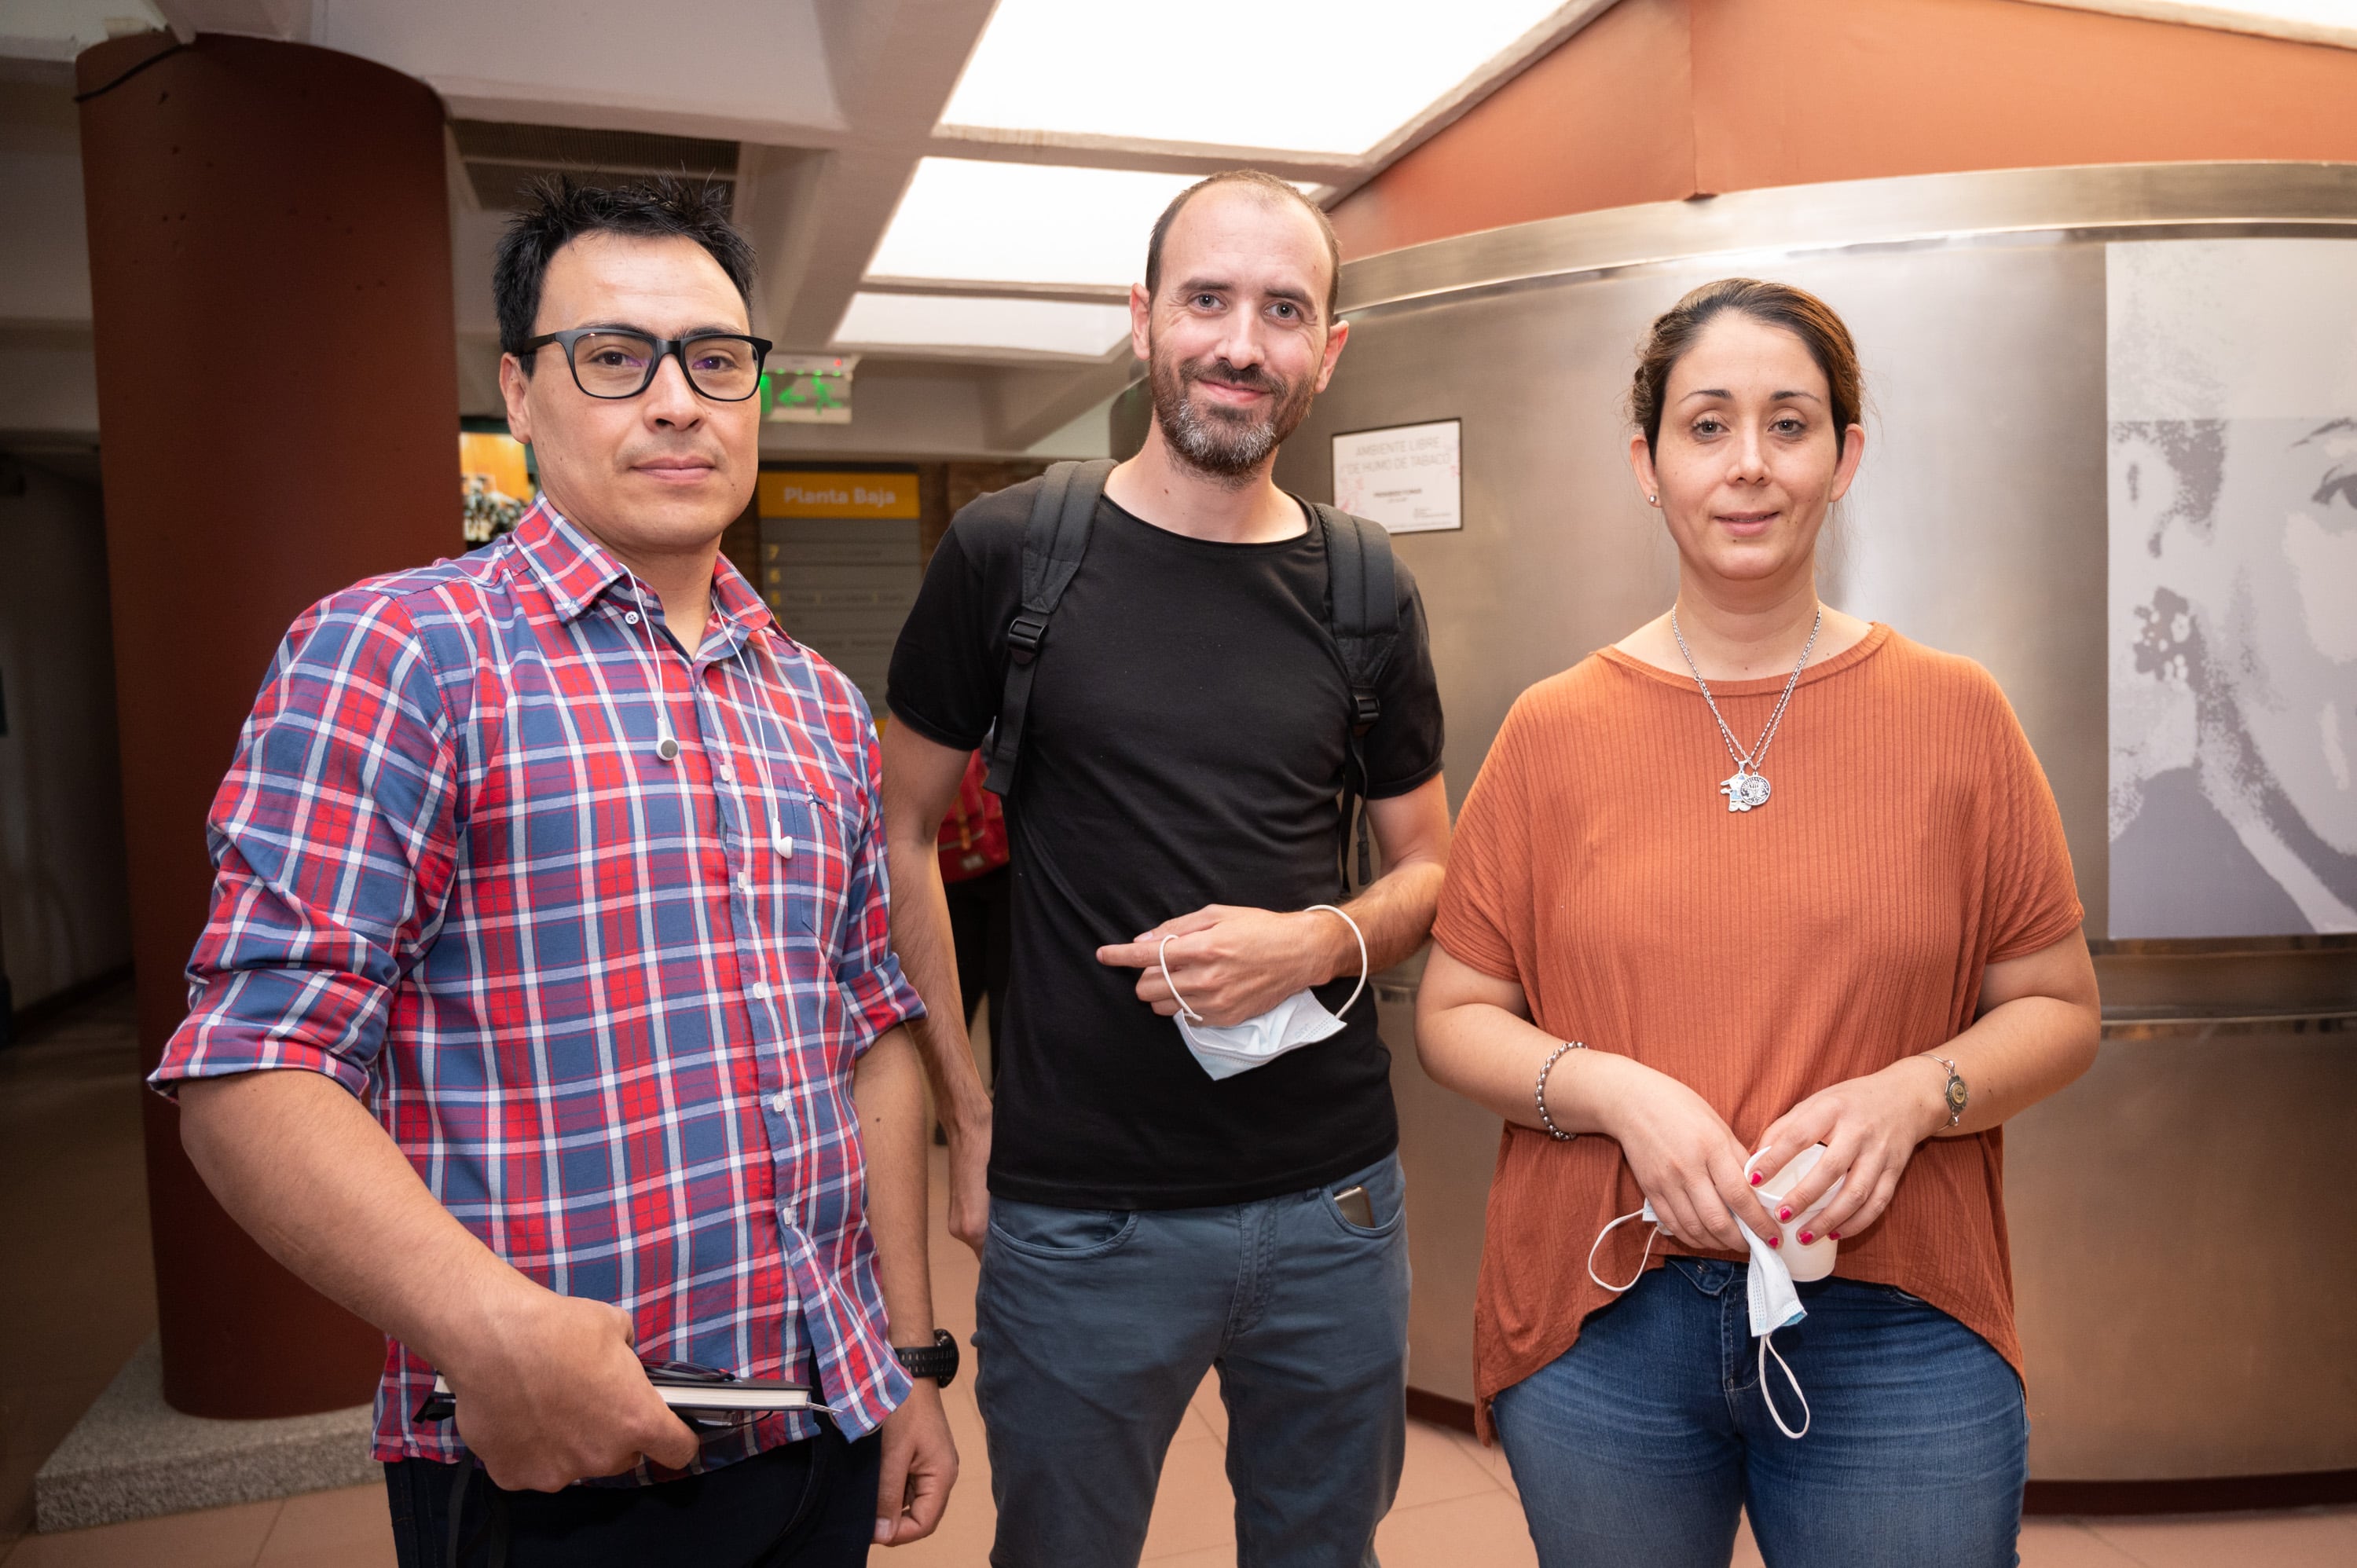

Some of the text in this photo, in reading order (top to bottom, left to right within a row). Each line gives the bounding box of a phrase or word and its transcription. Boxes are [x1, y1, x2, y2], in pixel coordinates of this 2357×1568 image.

[1356, 437, 1440, 456] AMBIENTE LIBRE
[1347, 453, 1451, 474] DE HUMO DE TABACO
[784, 487, 896, 507] Planta Baja
